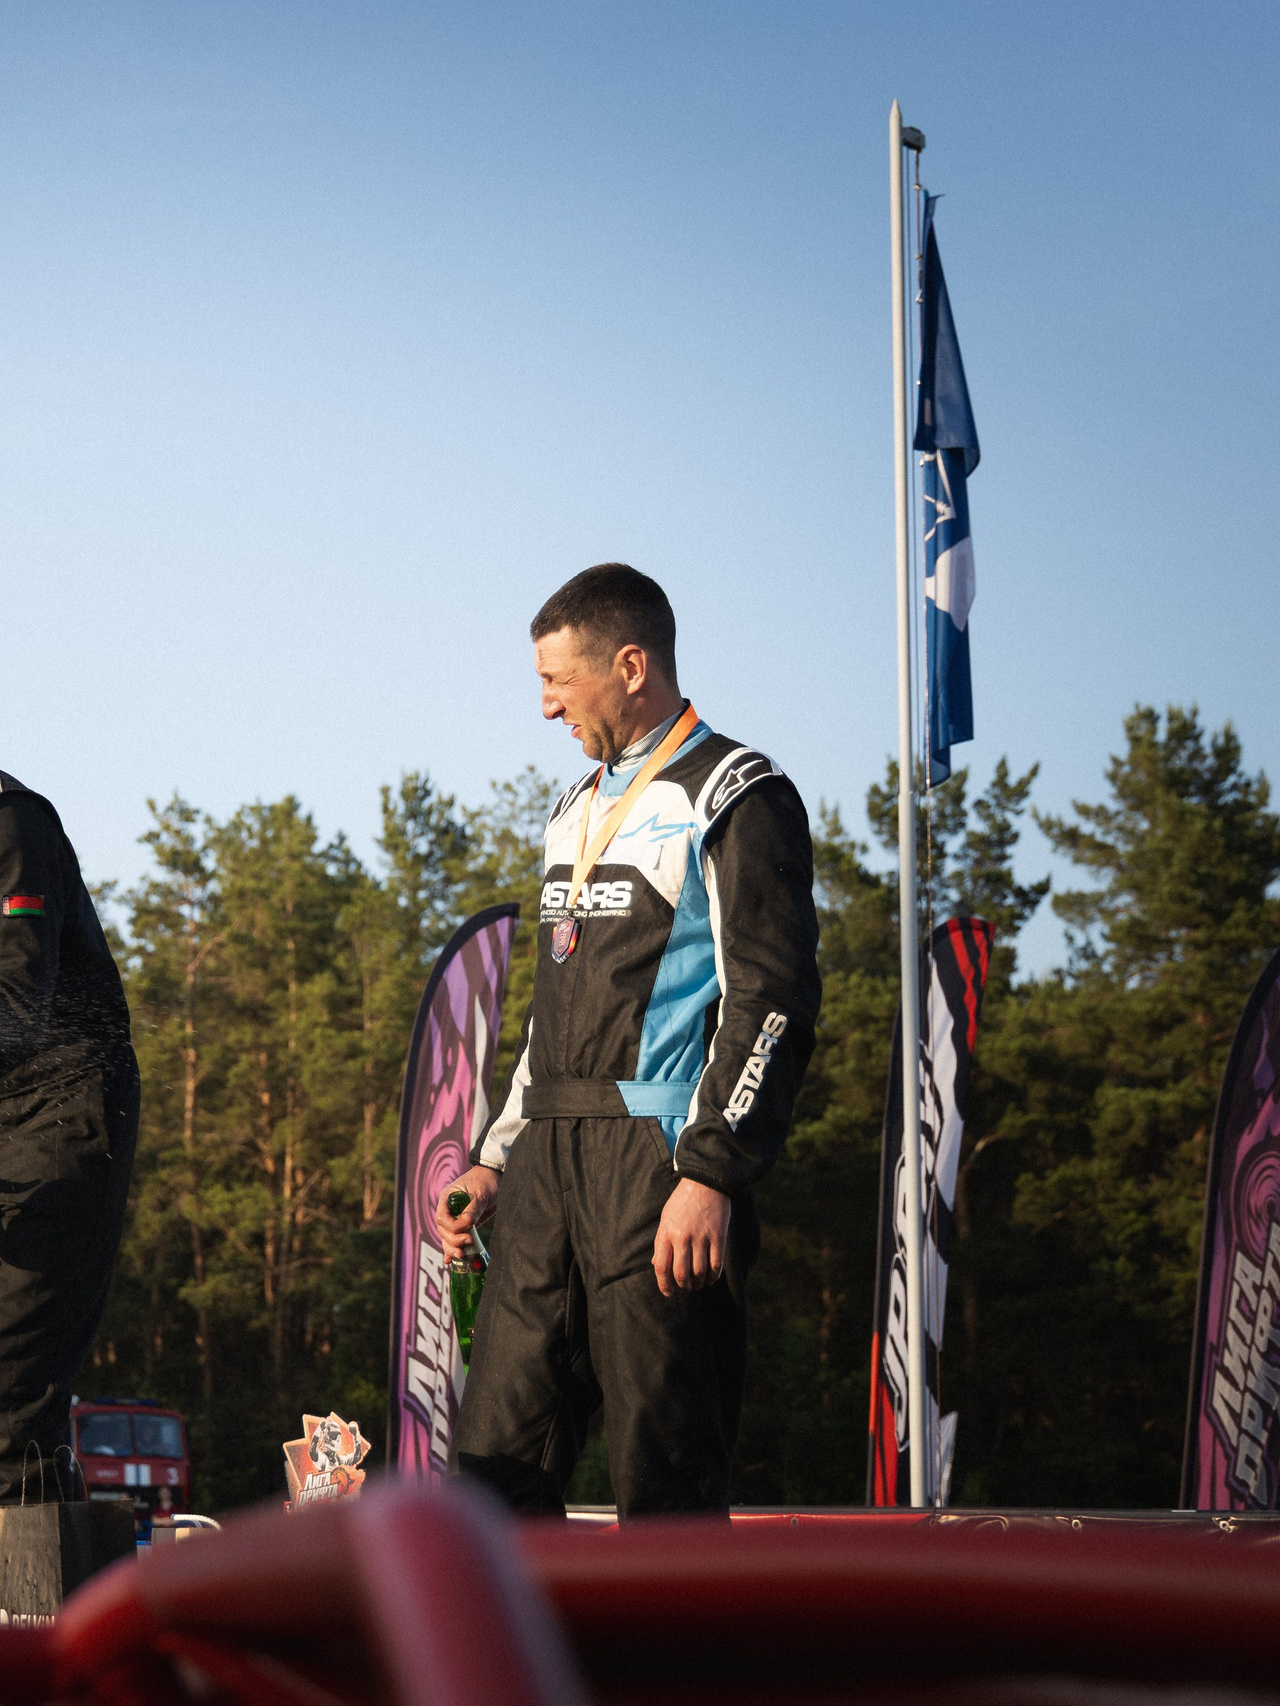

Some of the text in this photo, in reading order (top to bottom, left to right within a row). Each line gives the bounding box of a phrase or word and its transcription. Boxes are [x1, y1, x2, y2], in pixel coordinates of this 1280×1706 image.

[540, 881, 632, 910] ASTARS
[722, 1012, 788, 1132] ASTARS
[407, 1240, 444, 1423] ЛИГА
[430, 1264, 452, 1462] ДРИФ
[1211, 1251, 1262, 1448] ЛИГА
[166, 1467, 180, 1485] 3
[303, 1472, 332, 1491] ЛИГА
